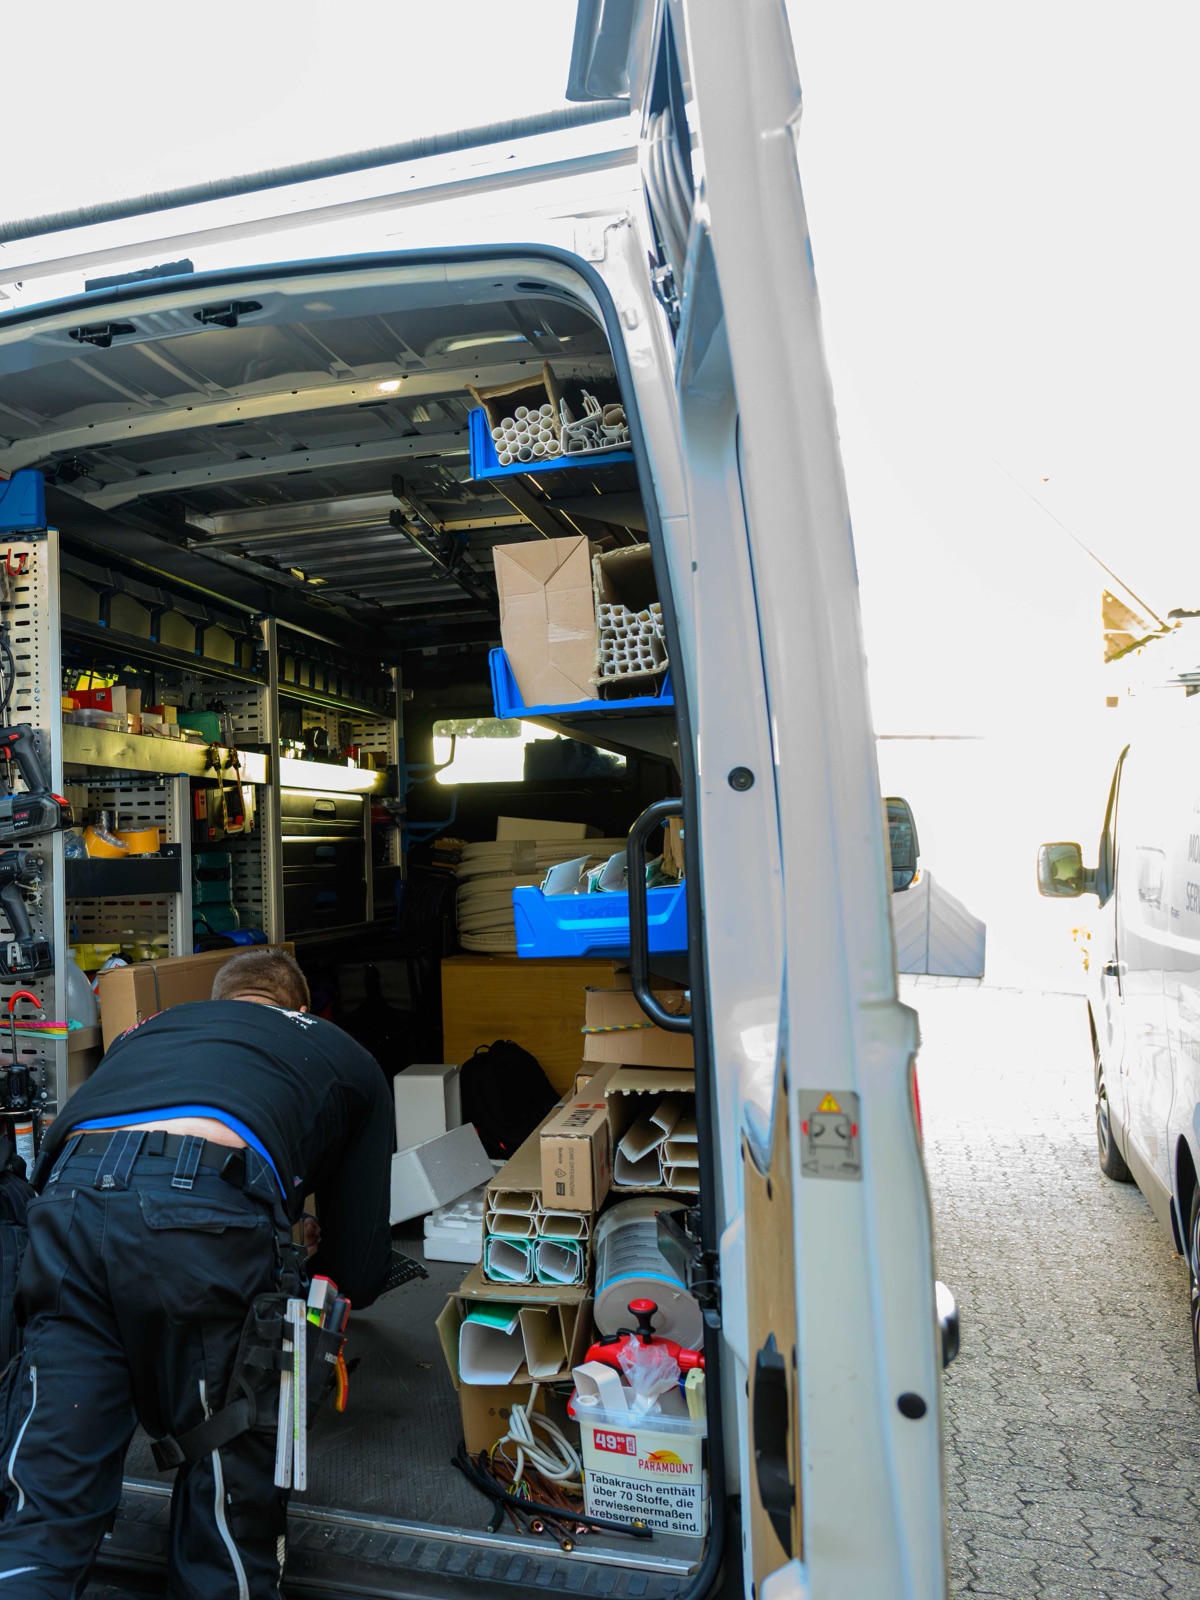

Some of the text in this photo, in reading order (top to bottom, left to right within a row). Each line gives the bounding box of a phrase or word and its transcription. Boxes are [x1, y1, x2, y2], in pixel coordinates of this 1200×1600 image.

[638, 1458, 694, 1474] PARAMOUNT
[590, 1472, 696, 1497] Tabakrauch enthält
[593, 1485, 694, 1509] über 70 Stoffe, die
[594, 1498, 693, 1520] erwiesenermaßen
[590, 1507, 699, 1532] krebserregend sind.
